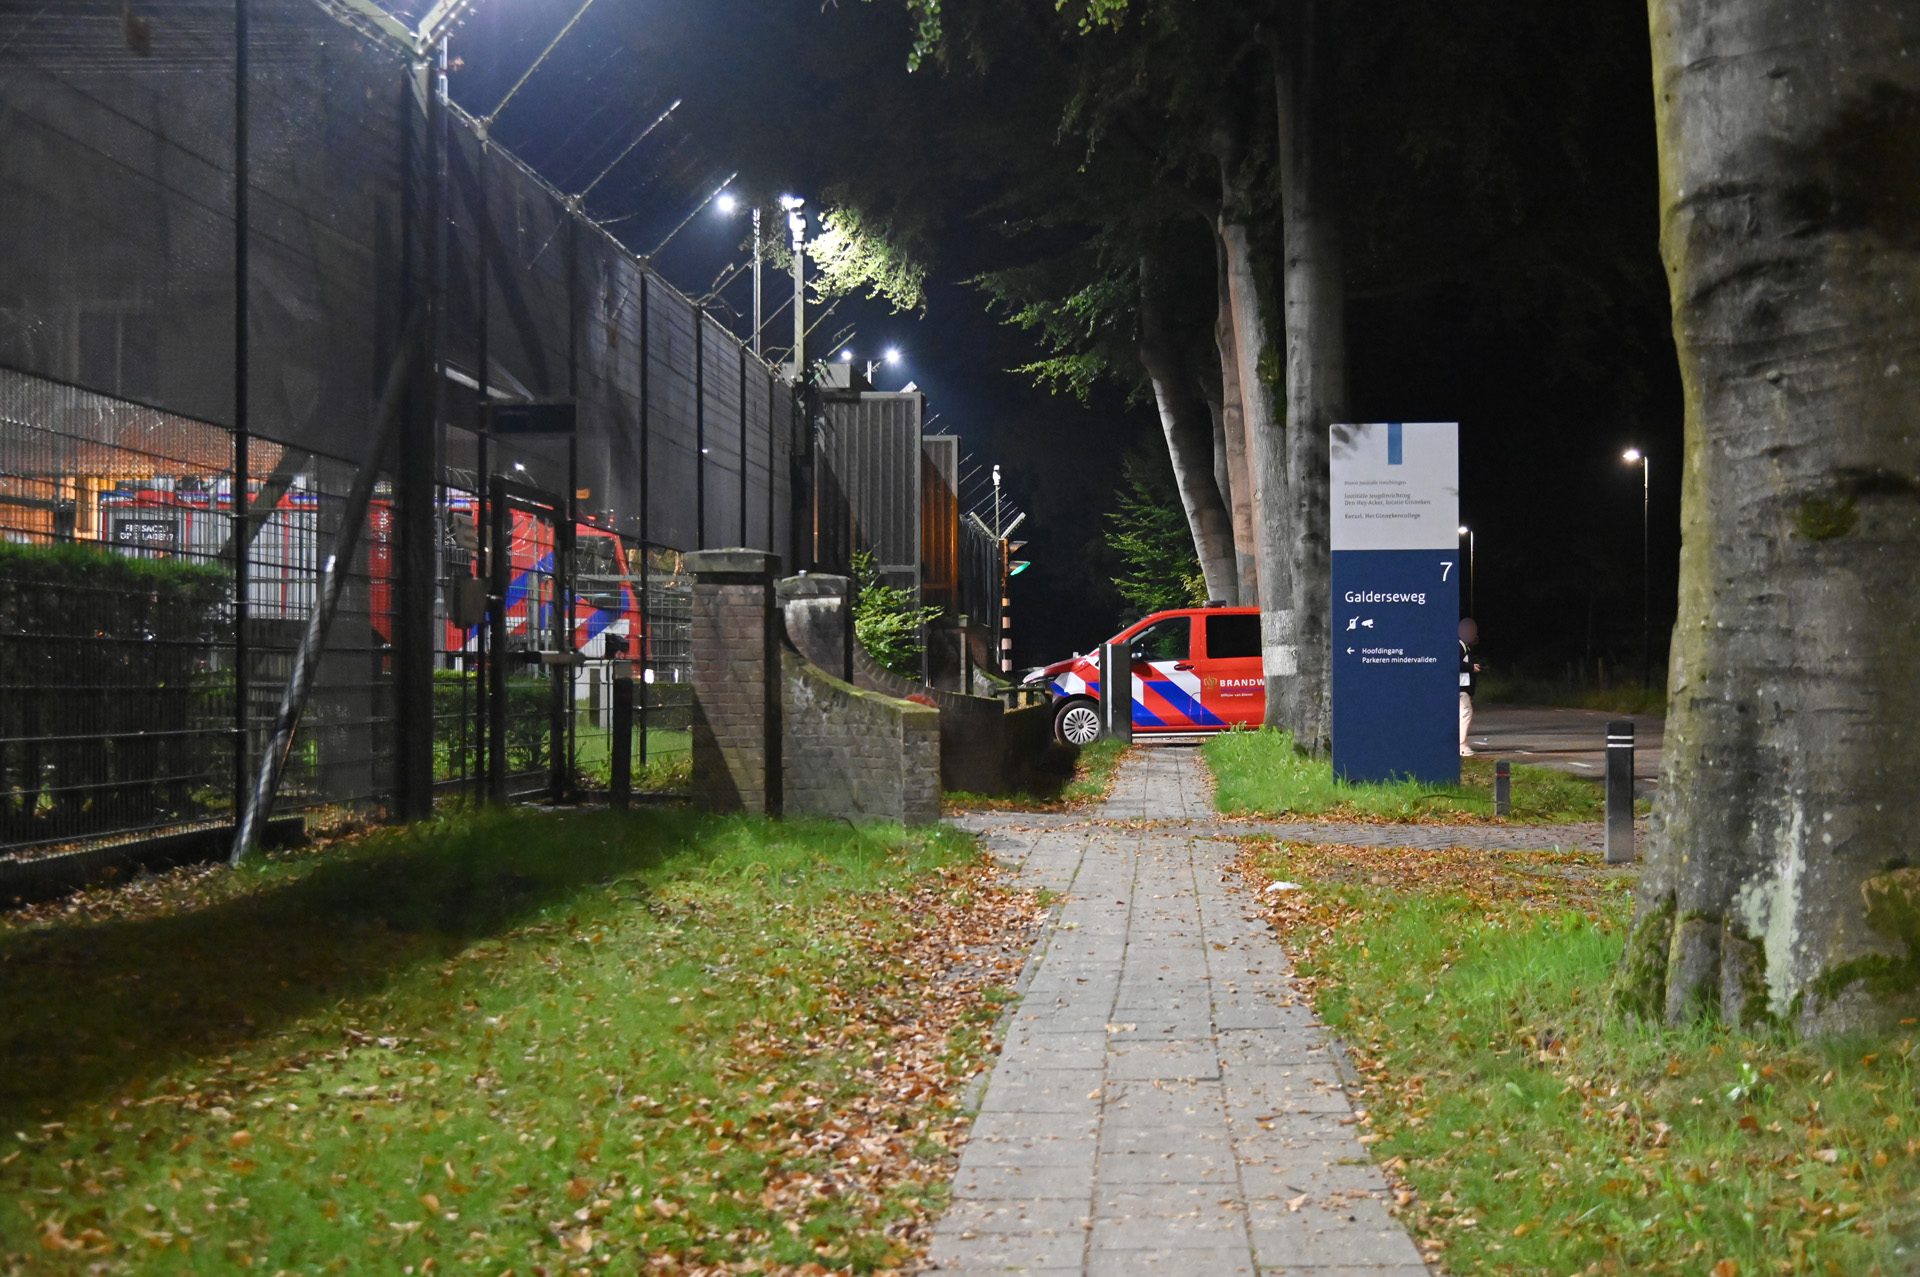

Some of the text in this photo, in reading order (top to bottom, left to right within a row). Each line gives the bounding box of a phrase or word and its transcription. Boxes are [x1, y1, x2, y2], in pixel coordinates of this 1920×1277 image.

[1440, 562, 1453, 582] 7
[1345, 591, 1426, 605] Galderseweg
[1362, 647, 1403, 655] Hoofdingang
[1362, 656, 1390, 664] Parkeren
